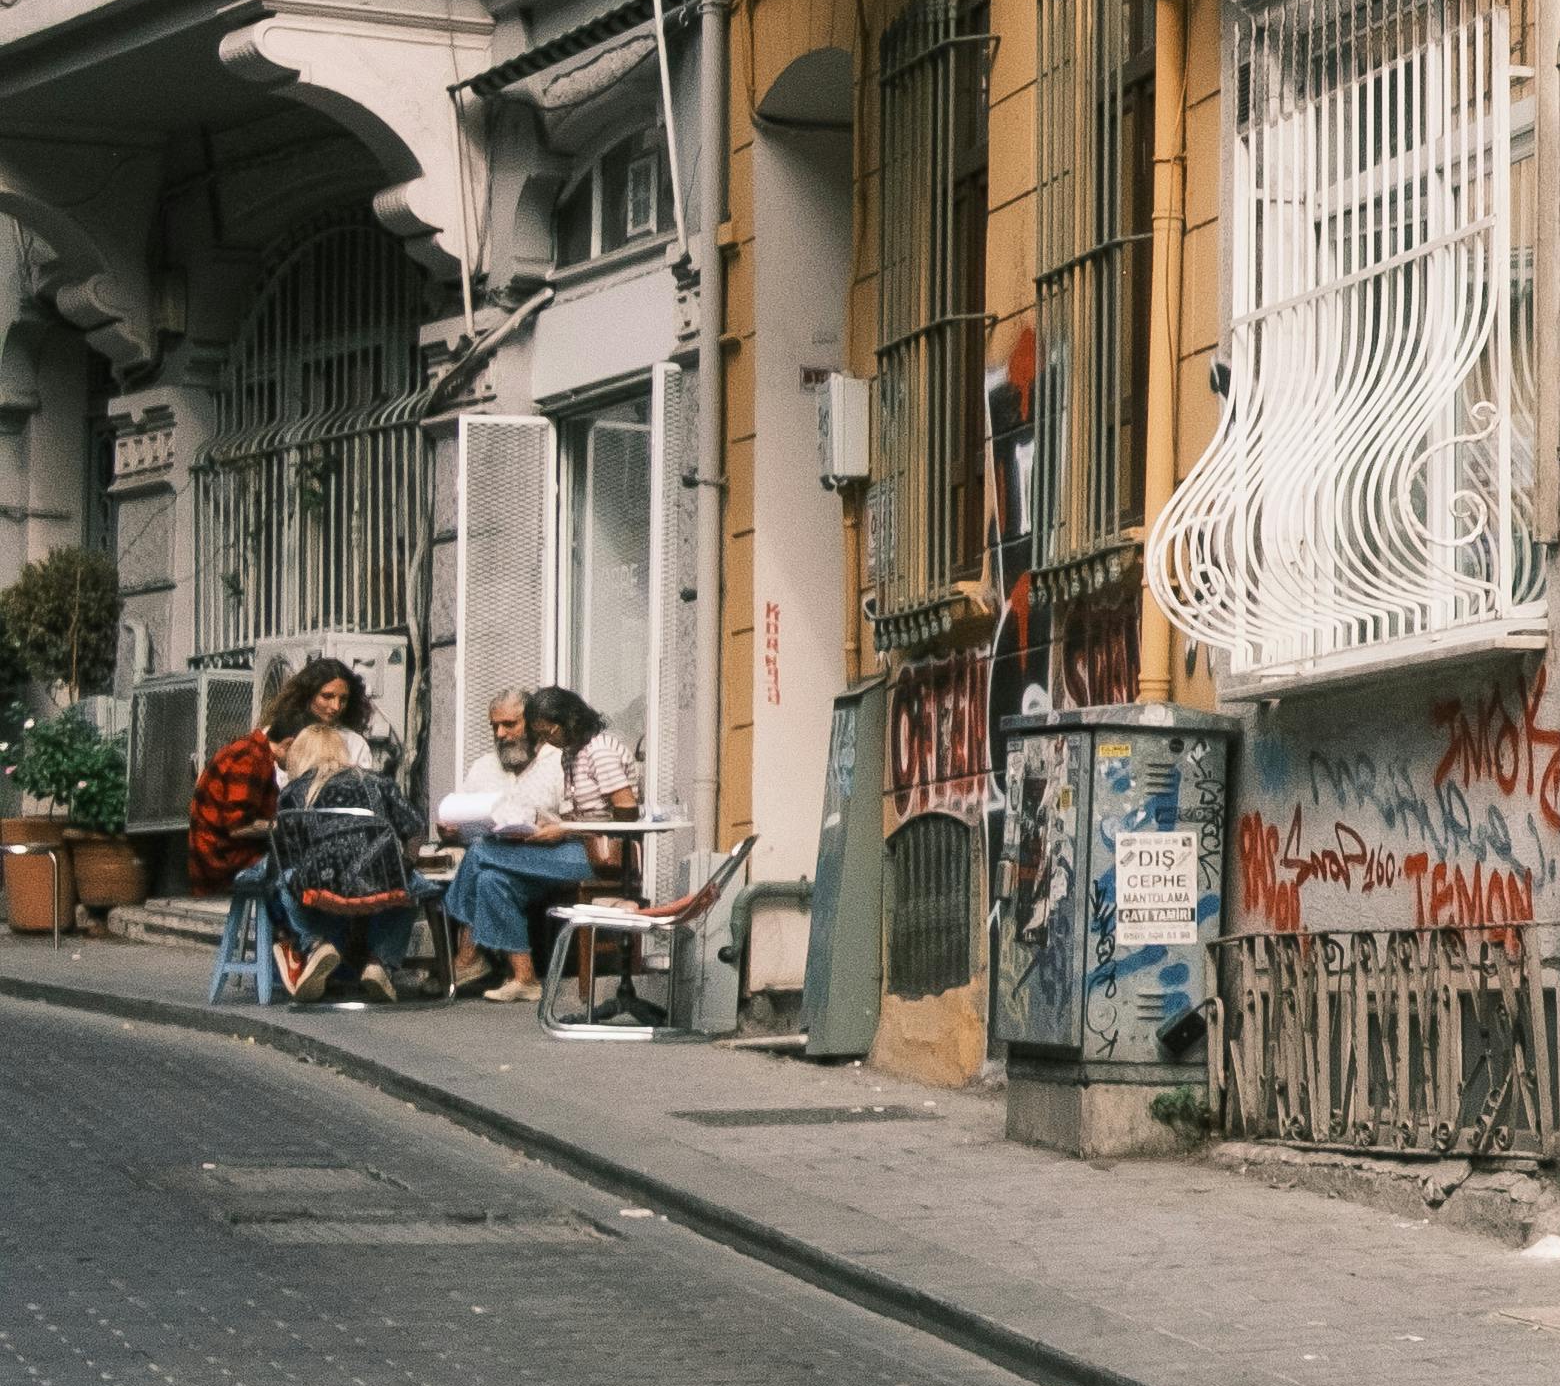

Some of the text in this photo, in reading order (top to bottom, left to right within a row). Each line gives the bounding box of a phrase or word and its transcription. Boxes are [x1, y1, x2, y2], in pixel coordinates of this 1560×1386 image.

[1140, 850, 1175, 870] DIŞ
[1127, 874, 1187, 888] CEPHE
[1123, 893, 1190, 903] MANTOLAMA
